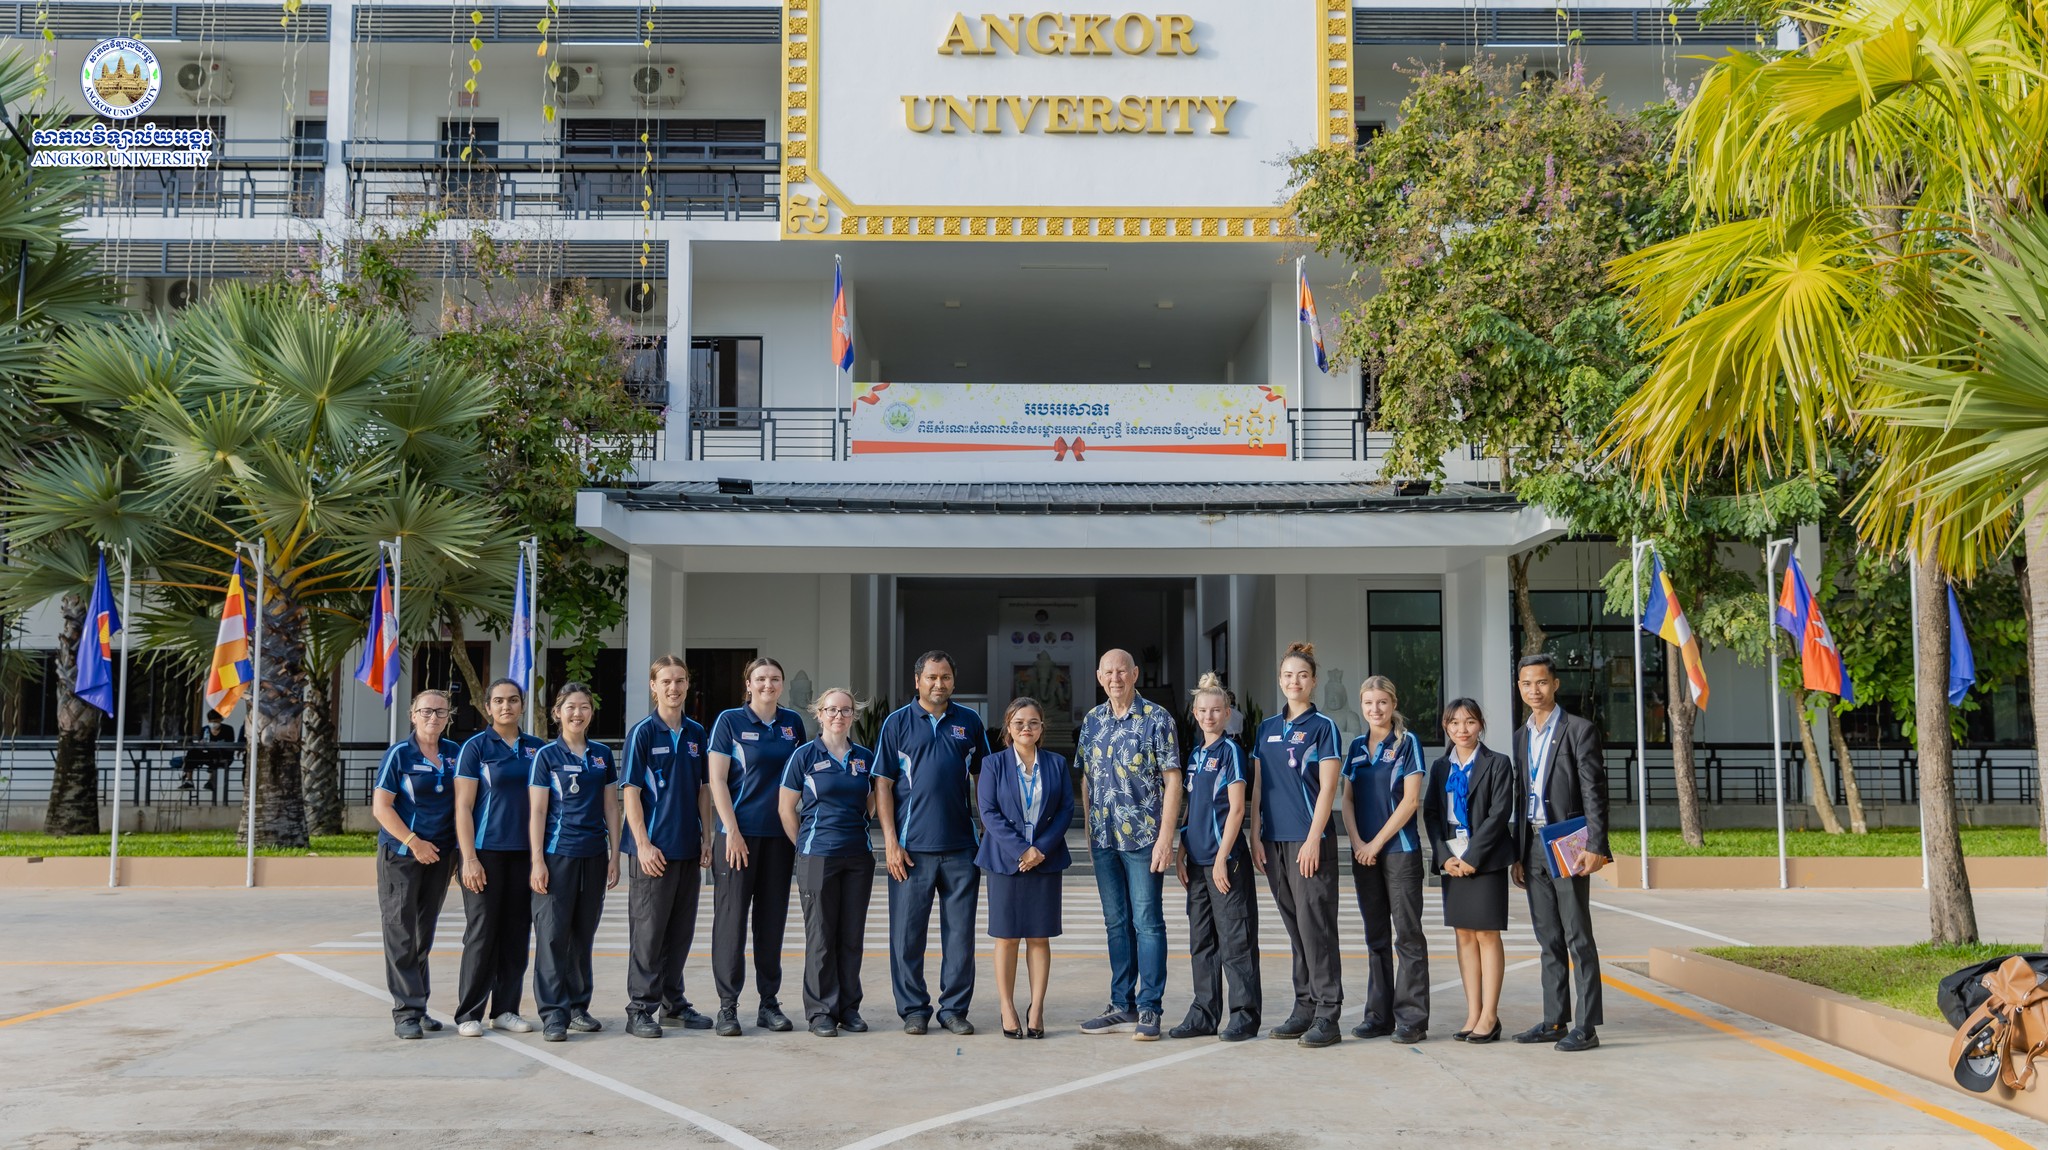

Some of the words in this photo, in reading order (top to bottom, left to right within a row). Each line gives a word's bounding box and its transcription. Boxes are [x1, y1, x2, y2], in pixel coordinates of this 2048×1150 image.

[937, 12, 1199, 56] ANGKOR
[900, 95, 1237, 134] UNIVERSITY
[1024, 403, 1110, 416] អបអរសាទរ
